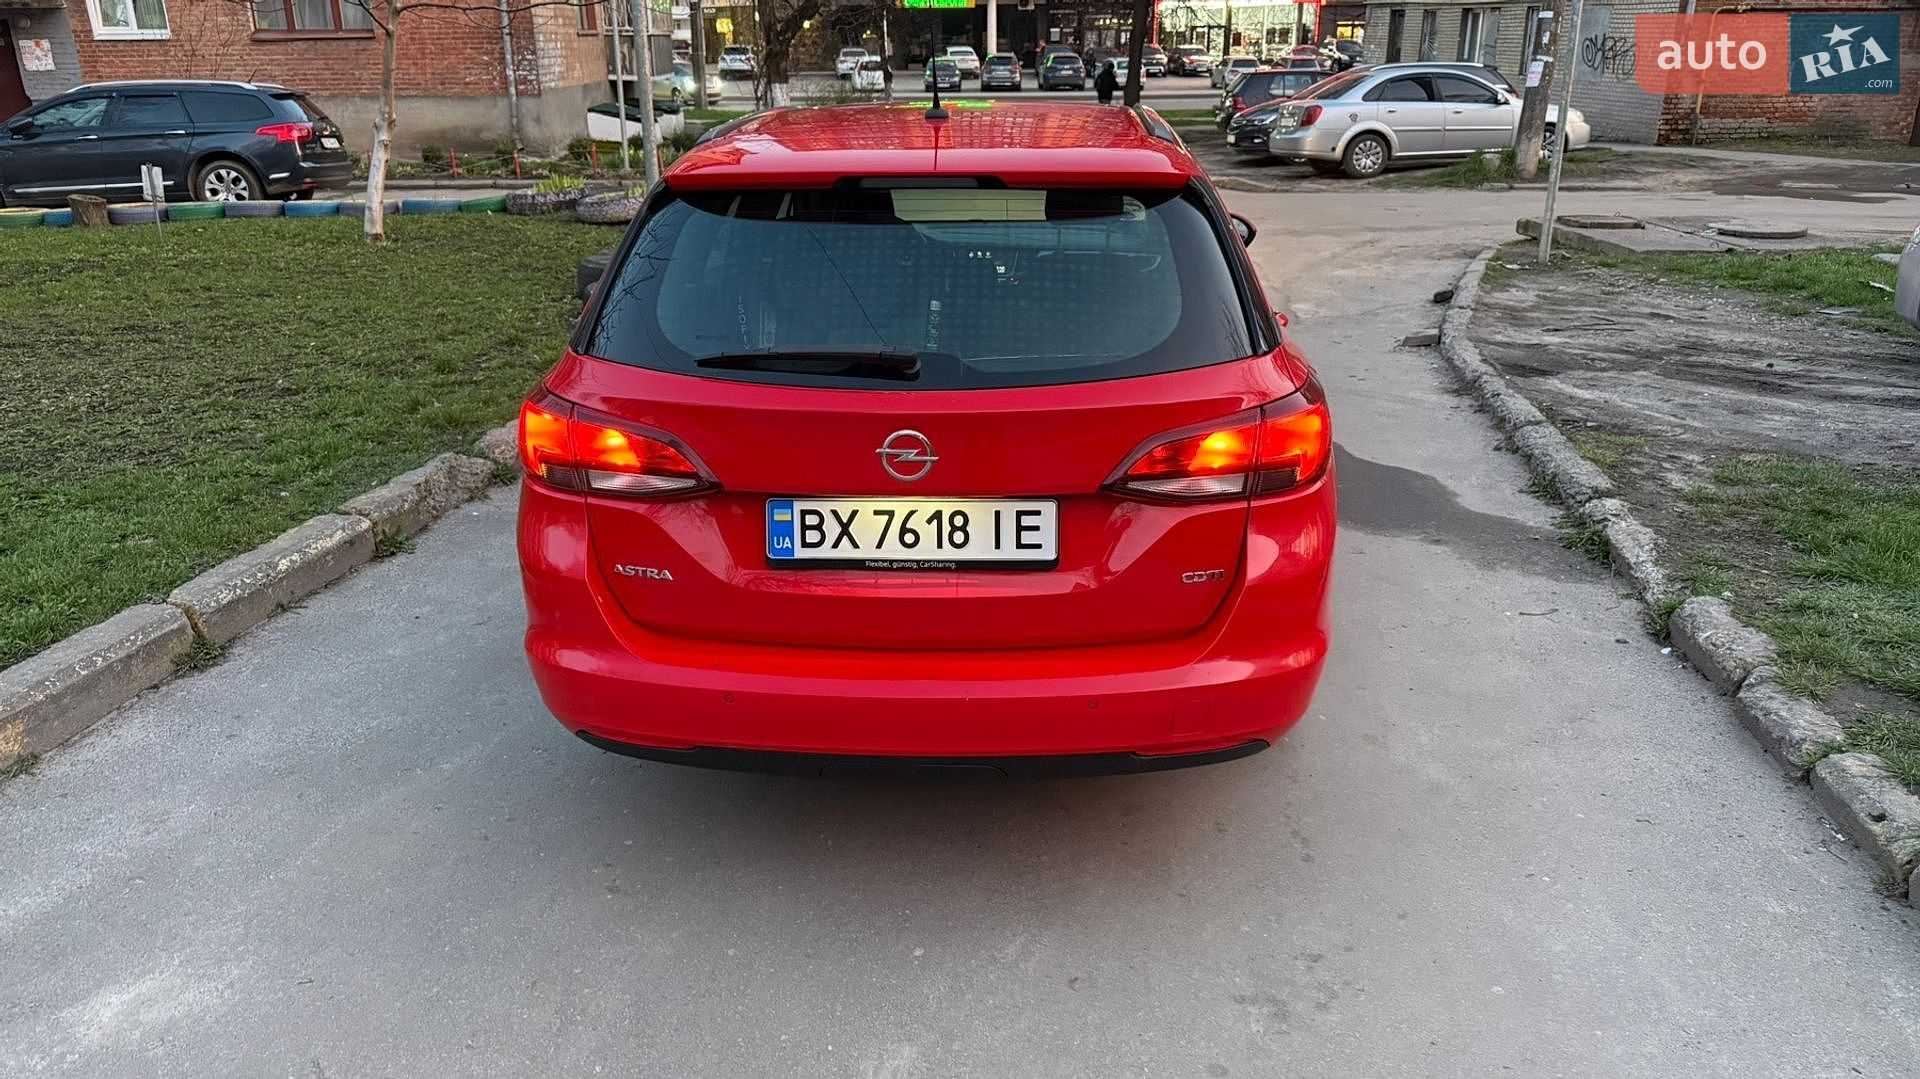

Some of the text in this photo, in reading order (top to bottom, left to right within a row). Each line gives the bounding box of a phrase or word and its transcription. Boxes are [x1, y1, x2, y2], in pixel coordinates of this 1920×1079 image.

[800, 508, 1043, 550] BX 7618 IE
[774, 536, 793, 549] UA
[614, 564, 674, 581] ASTRA
[865, 560, 891, 568] Flexibel,
[919, 560, 957, 570] CarSharing.
[1182, 569, 1225, 584] CDTI
